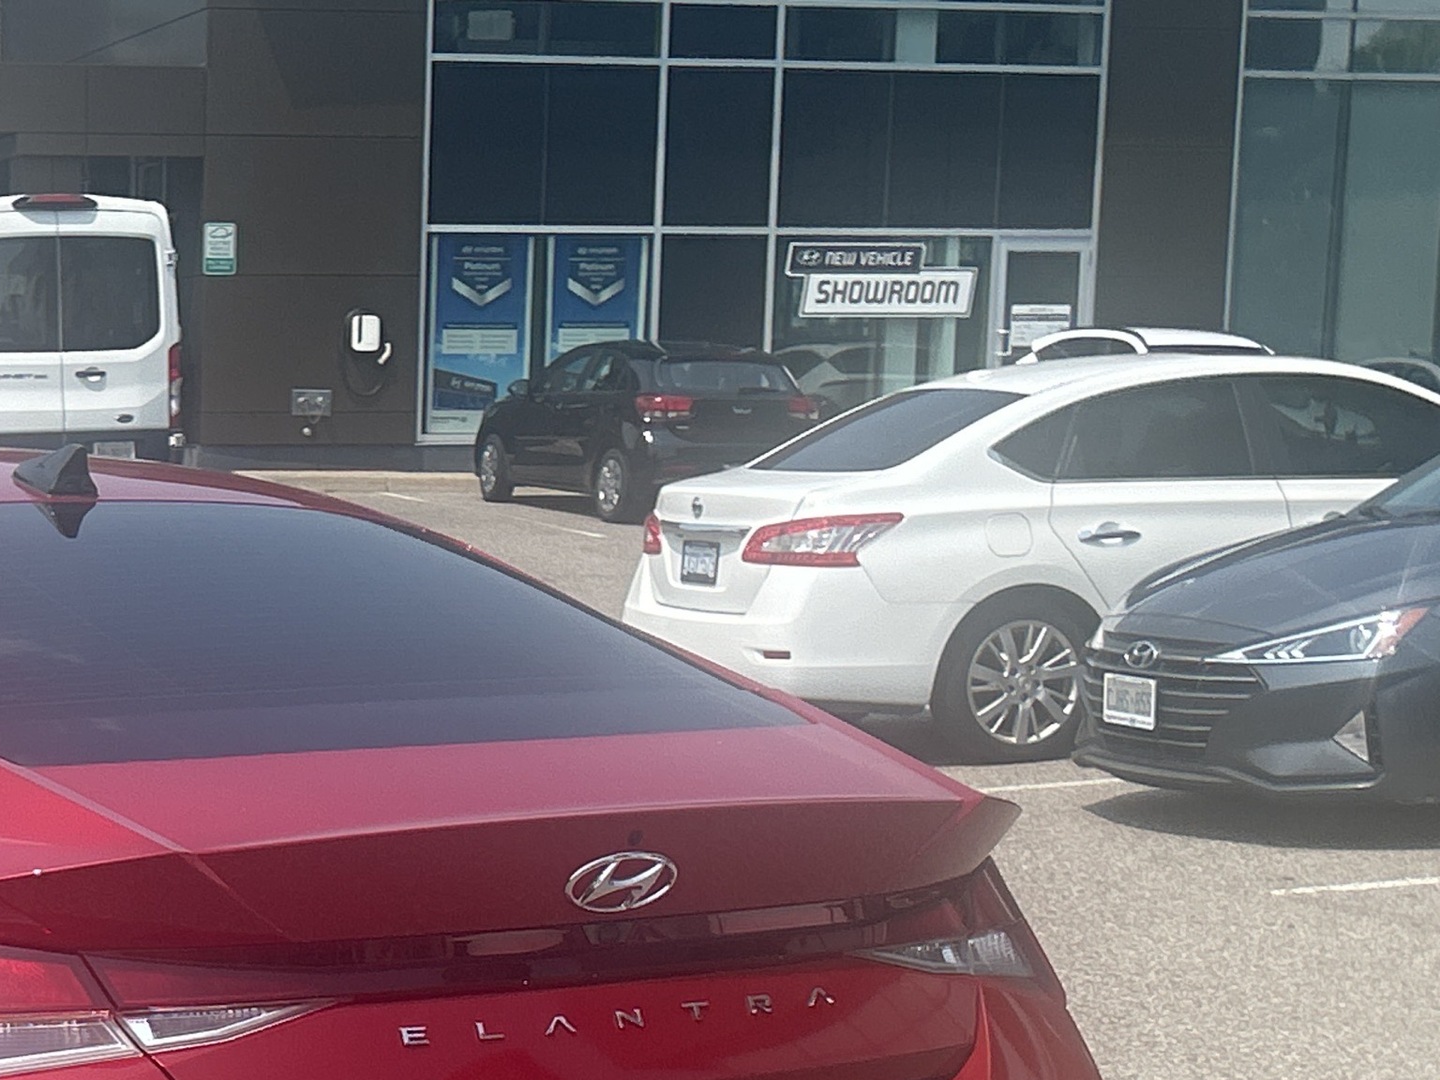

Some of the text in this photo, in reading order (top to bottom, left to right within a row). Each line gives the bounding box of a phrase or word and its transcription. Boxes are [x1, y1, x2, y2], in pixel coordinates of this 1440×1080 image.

[824, 251, 915, 266] NEW VEHICLE
[815, 280, 960, 304] SHOWROOM
[398, 986, 836, 1047] ELANTRA
